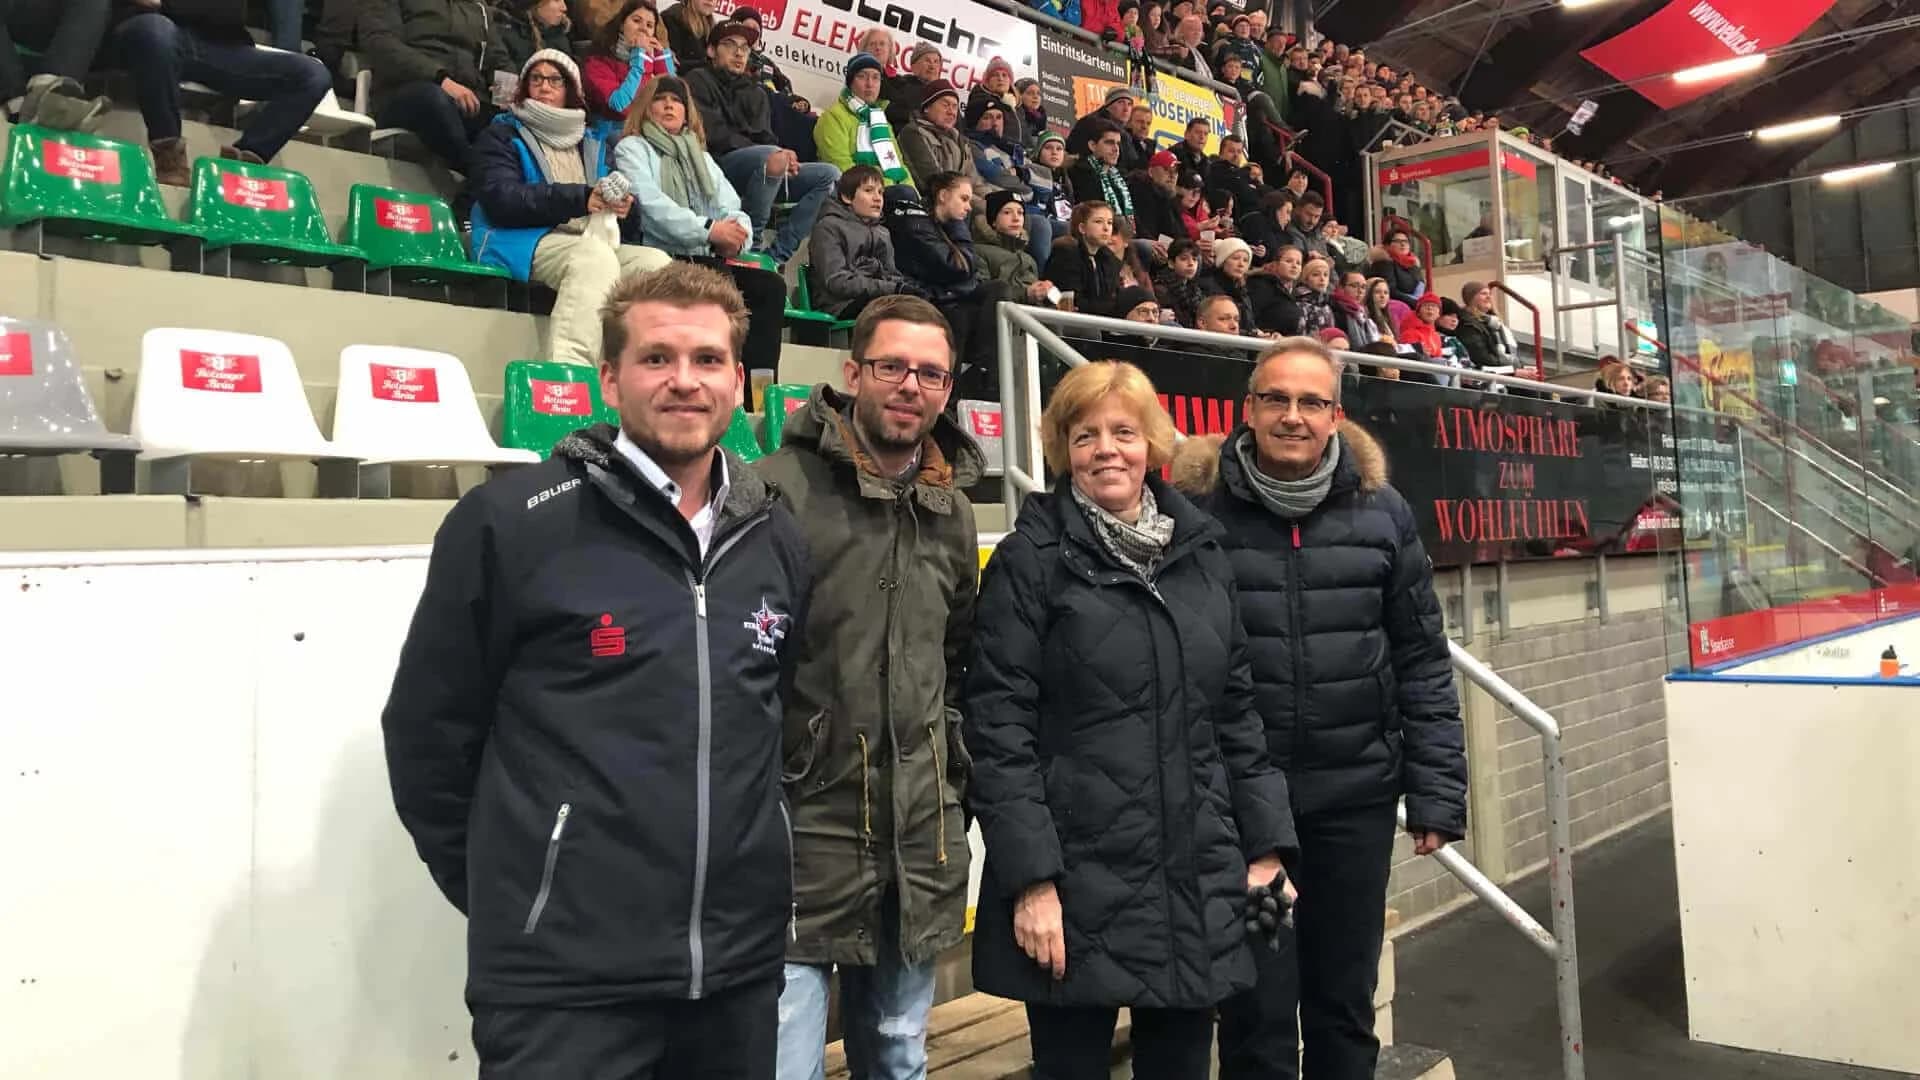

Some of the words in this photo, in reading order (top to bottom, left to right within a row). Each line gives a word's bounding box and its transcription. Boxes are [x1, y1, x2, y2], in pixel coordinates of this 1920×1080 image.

[1040, 34, 1111, 73] Eintrittskarten
[1112, 61, 1125, 78] im
[1433, 407, 1583, 457] ATMOSPHÄRE
[1499, 462, 1534, 489] ZUM
[1434, 493, 1588, 543] WOHLFÜHLEN
